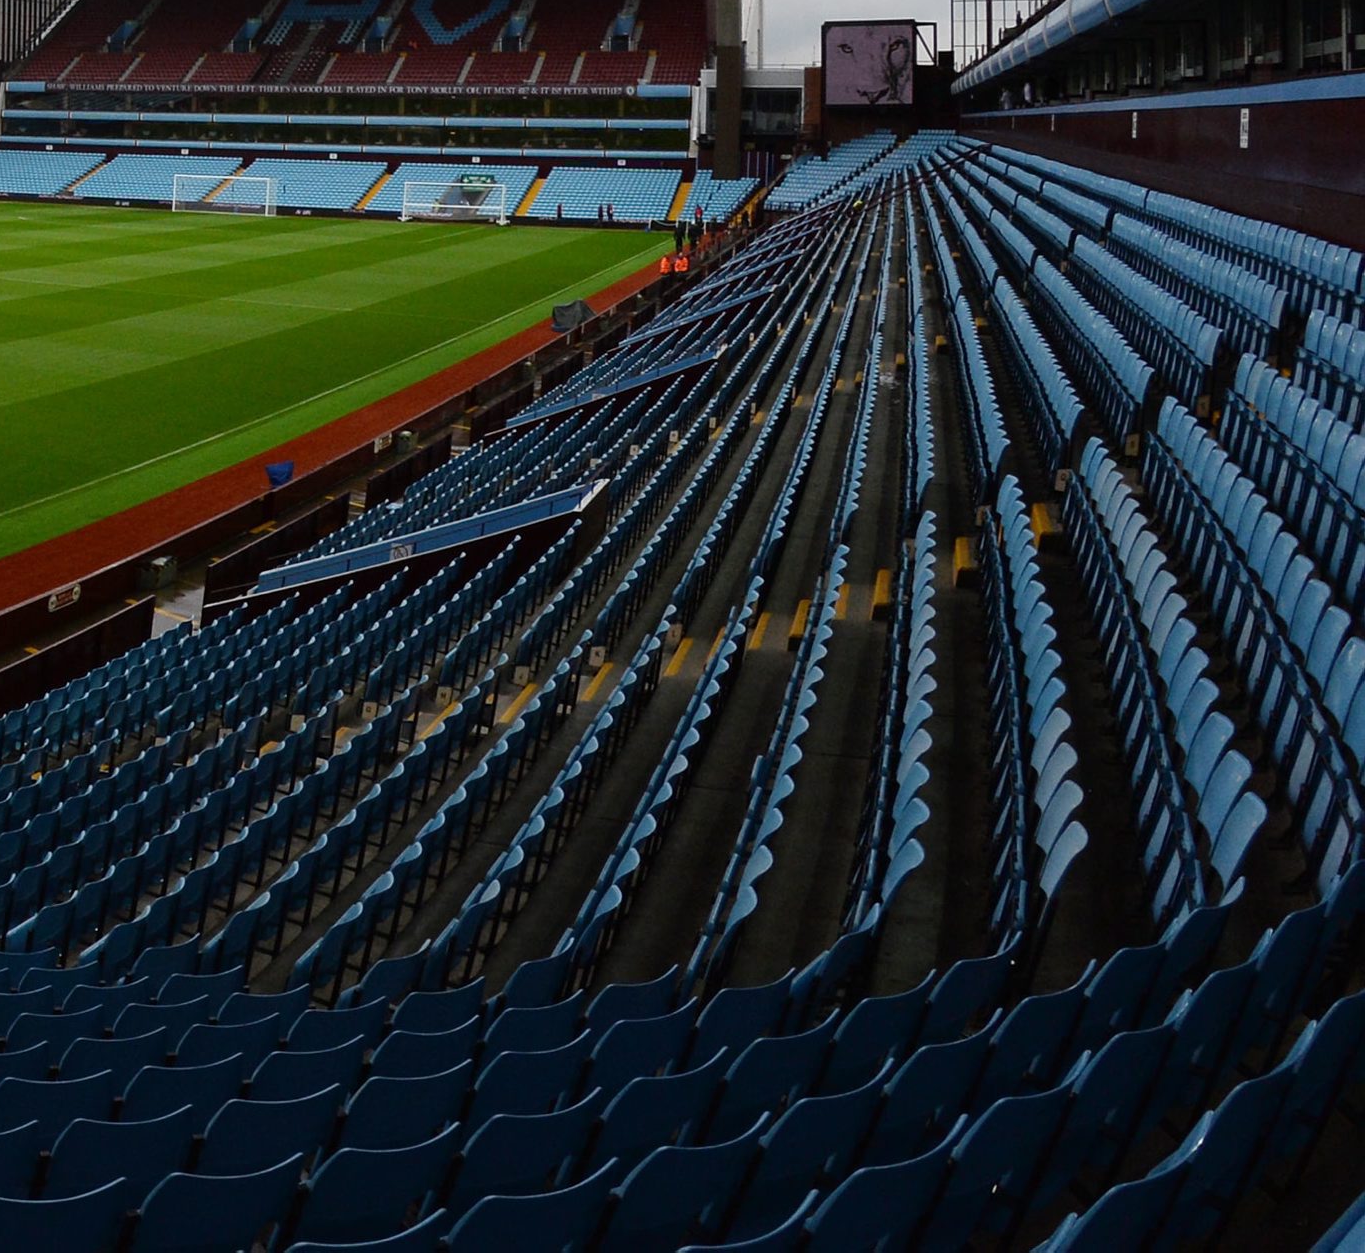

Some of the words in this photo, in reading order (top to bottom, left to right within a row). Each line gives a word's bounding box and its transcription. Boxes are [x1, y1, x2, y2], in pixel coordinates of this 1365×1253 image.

[106, 84, 143, 92] PREPARED
[144, 84, 155, 92] TO
[156, 84, 191, 92] VENTURE
[194, 84, 217, 93] DOWN
[219, 84, 234, 93] THE
[292, 85, 298, 93] A
[299, 85, 322, 93] GOOD
[346, 86, 376, 94] PLAYED
[378, 86, 387, 94] IN
[389, 86, 404, 94] FOR
[407, 86, 429, 94] TONY
[483, 86, 492, 94] IT
[494, 86, 516, 95] MUST
[541, 87, 549, 95] IT
[564, 87, 588, 95] PETER
